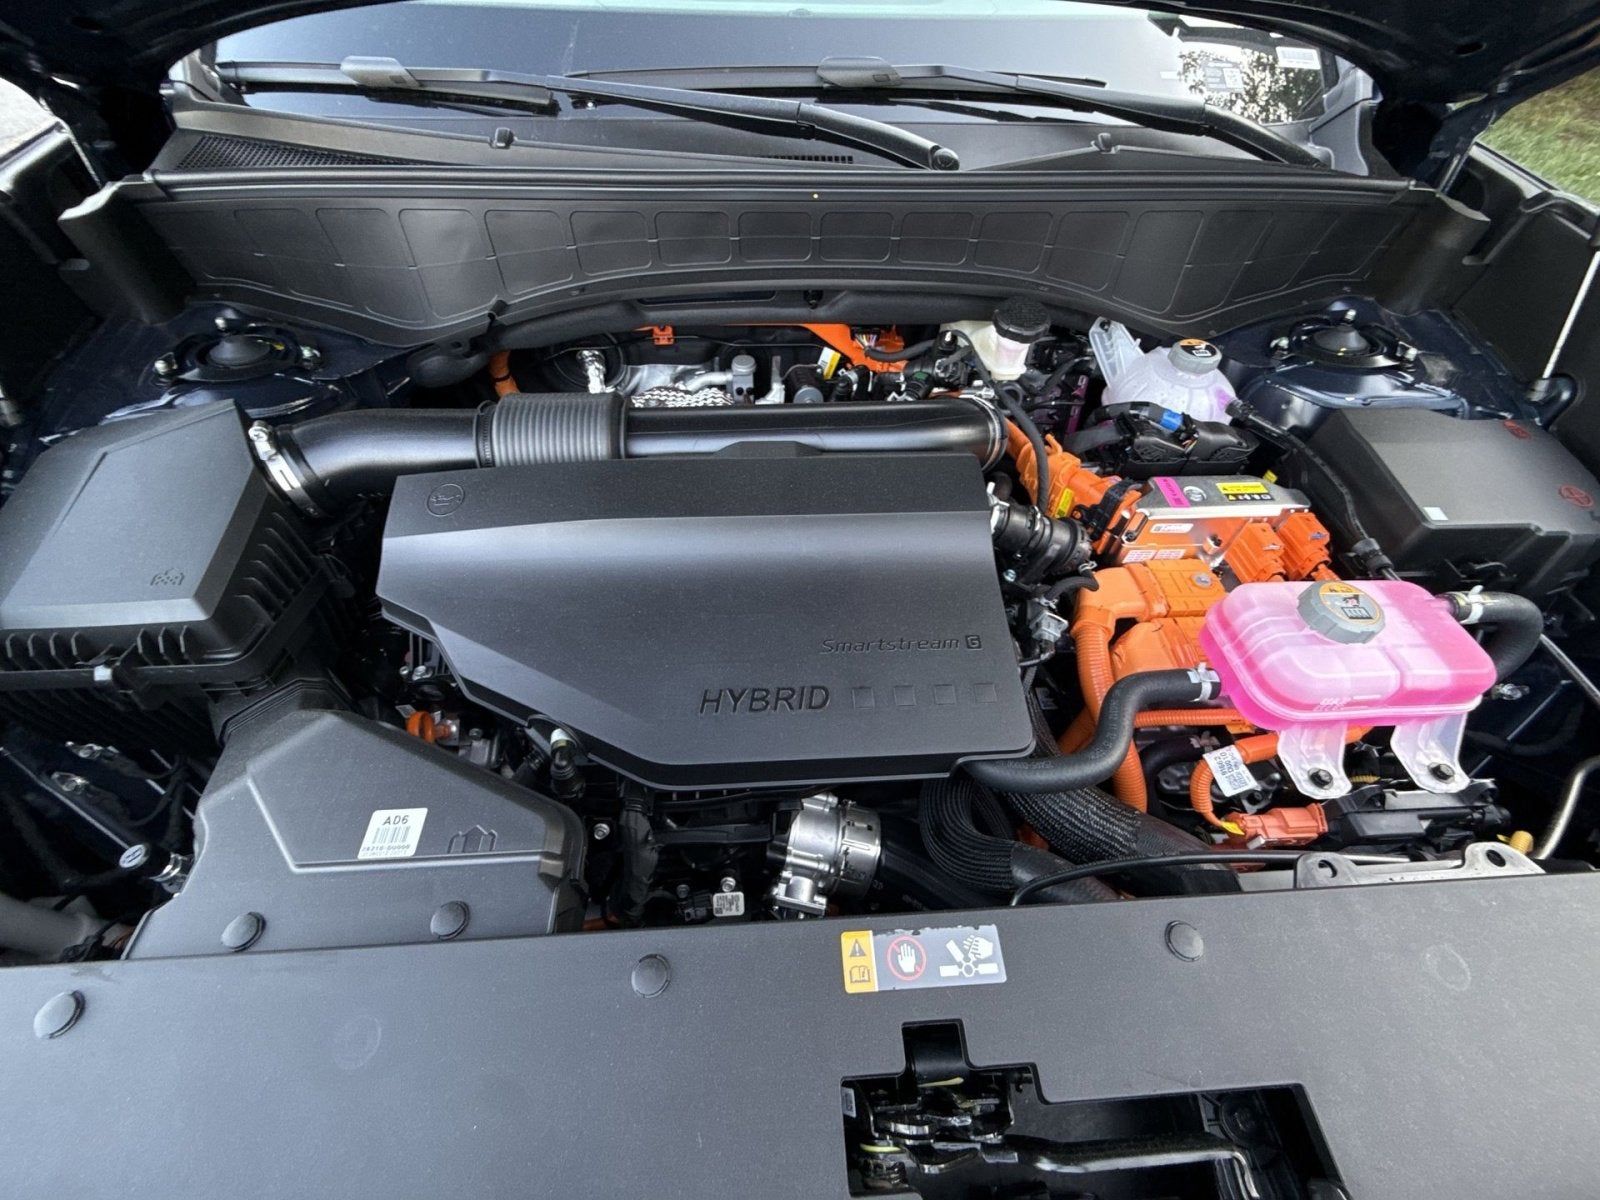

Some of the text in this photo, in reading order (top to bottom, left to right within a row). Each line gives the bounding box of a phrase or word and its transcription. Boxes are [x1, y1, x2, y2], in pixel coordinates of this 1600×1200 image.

[821, 635, 982, 654] Smartstream G
[700, 685, 830, 714] HYBRID
[382, 815, 410, 826] AD6
